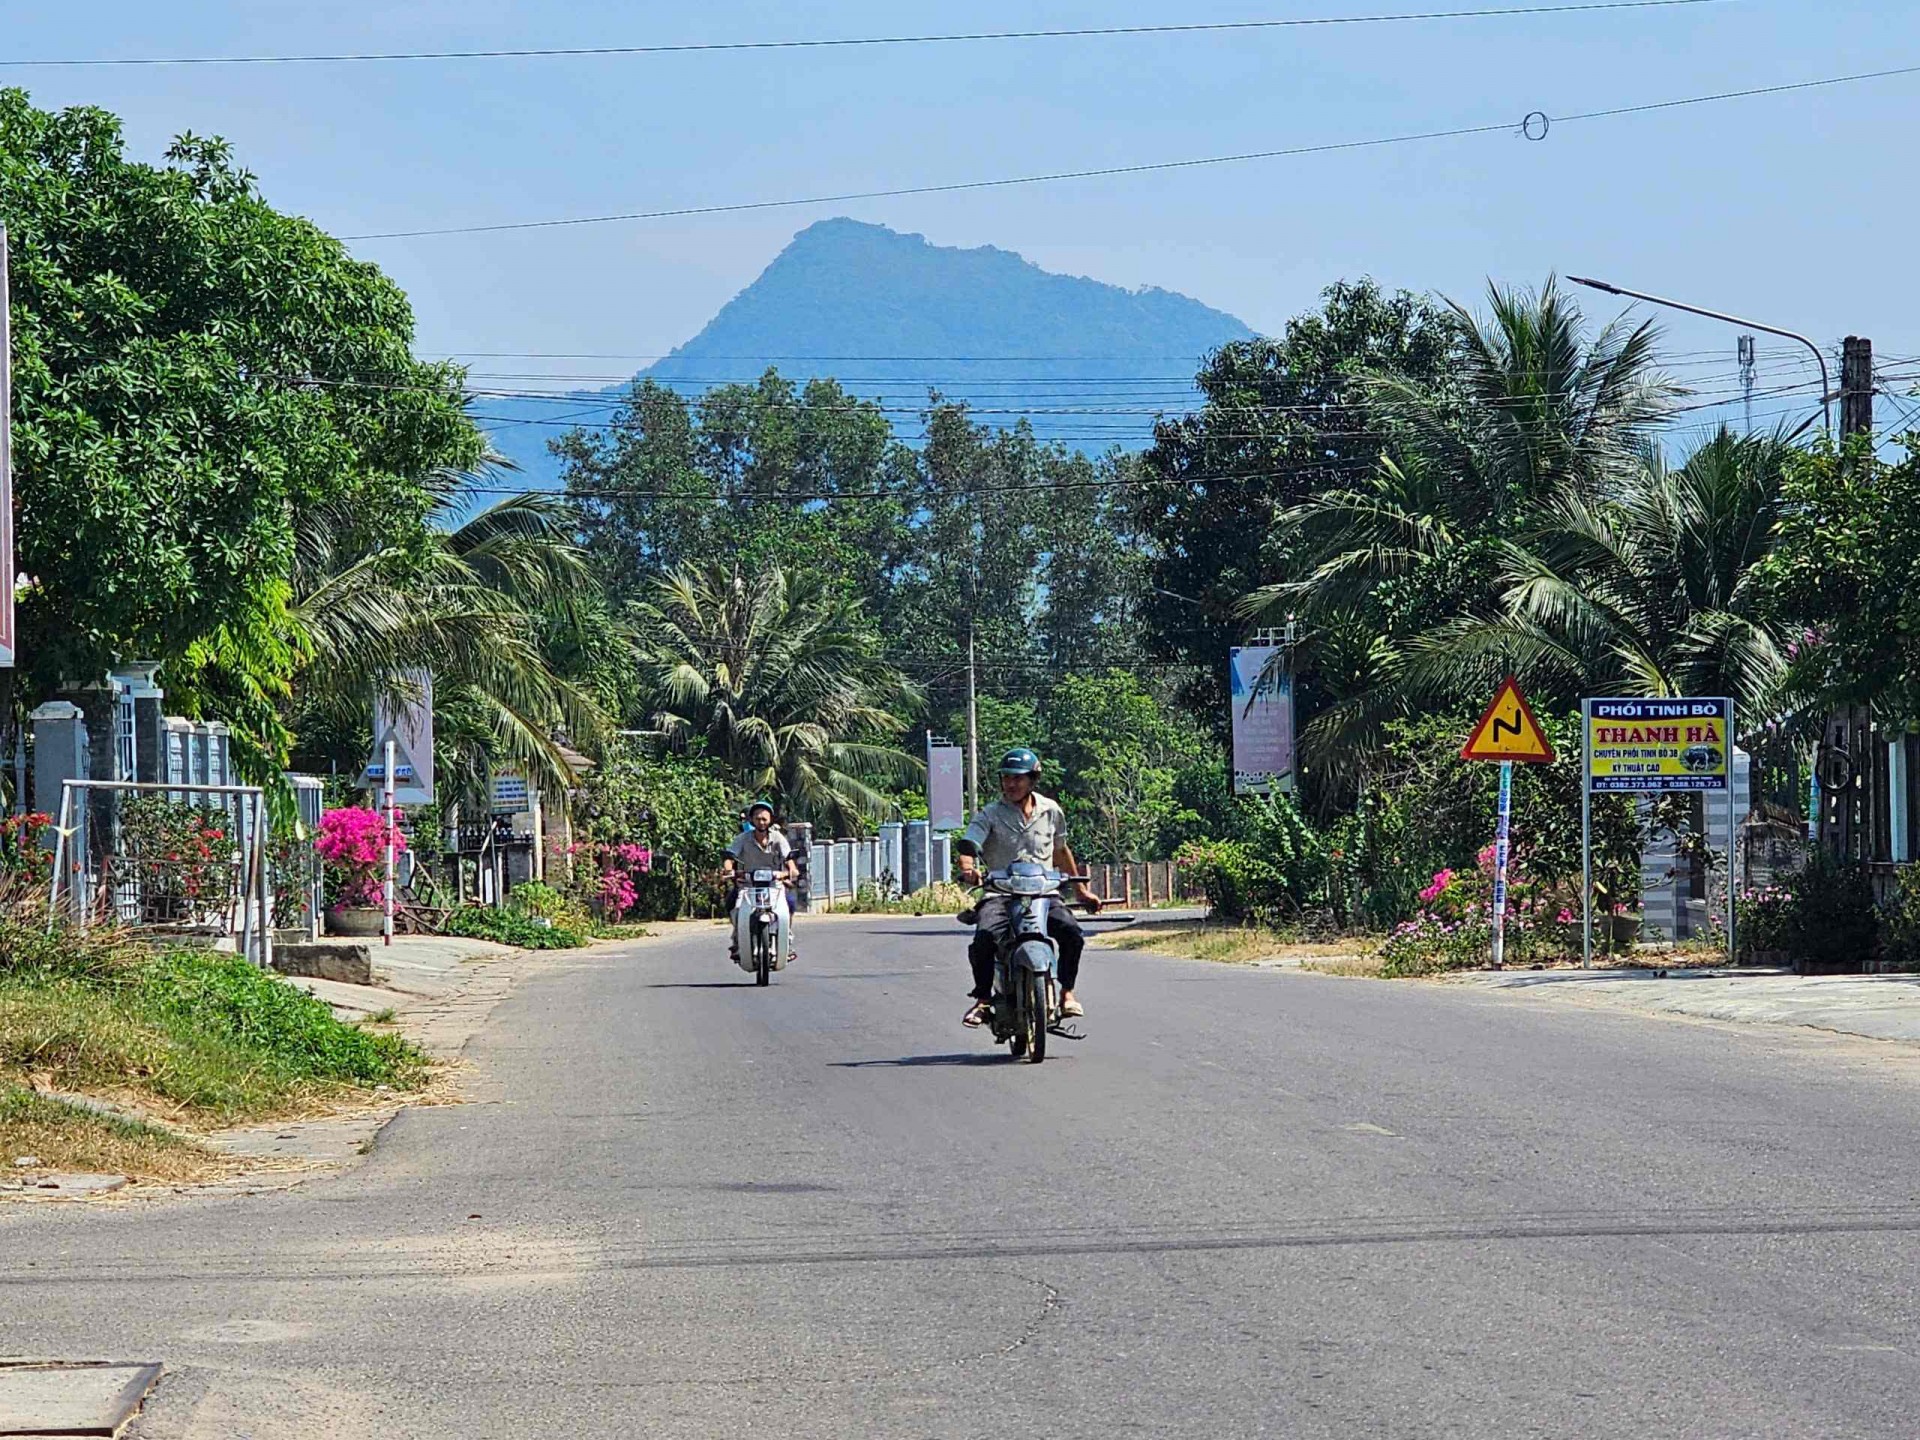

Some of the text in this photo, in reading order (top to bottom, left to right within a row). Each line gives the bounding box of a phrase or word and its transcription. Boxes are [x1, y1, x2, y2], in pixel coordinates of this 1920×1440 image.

[1599, 702, 1717, 716] PHỐI TINH BÒ
[1597, 722, 1721, 743] THANH HÀ
[1641, 749, 1657, 758] TINH
[1646, 764, 1660, 773] CAO
